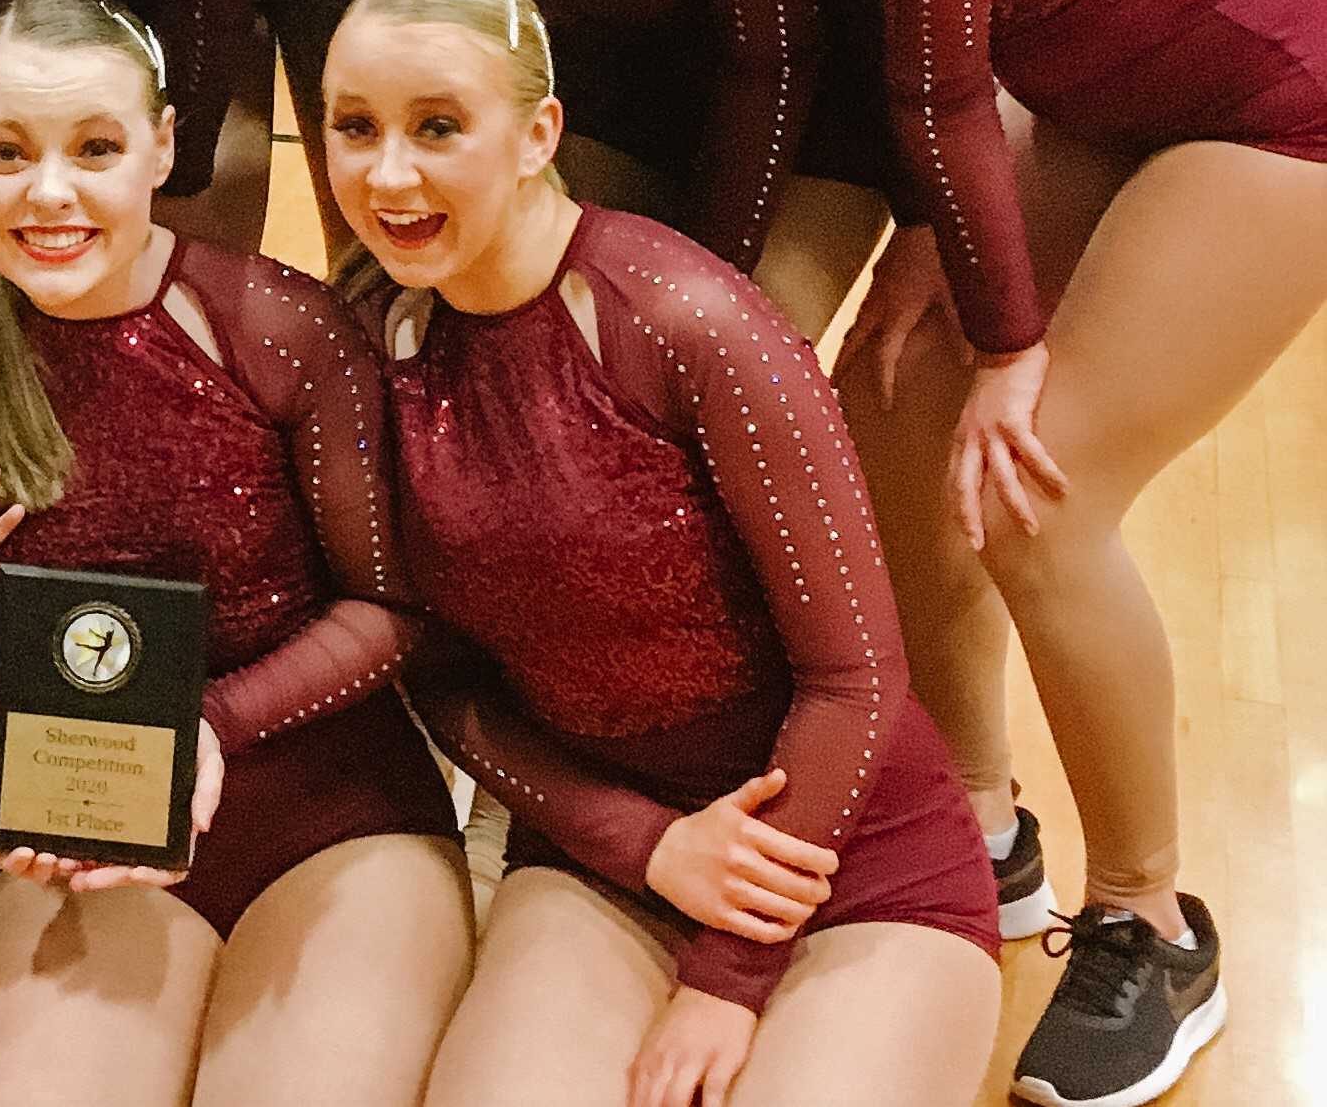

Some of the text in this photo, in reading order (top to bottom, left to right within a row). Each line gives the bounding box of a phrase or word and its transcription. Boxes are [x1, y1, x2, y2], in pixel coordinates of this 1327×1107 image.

[45, 726, 138, 752] Sherwood
[32, 748, 145, 776] Competition
[45, 809, 126, 833] 1st Place
